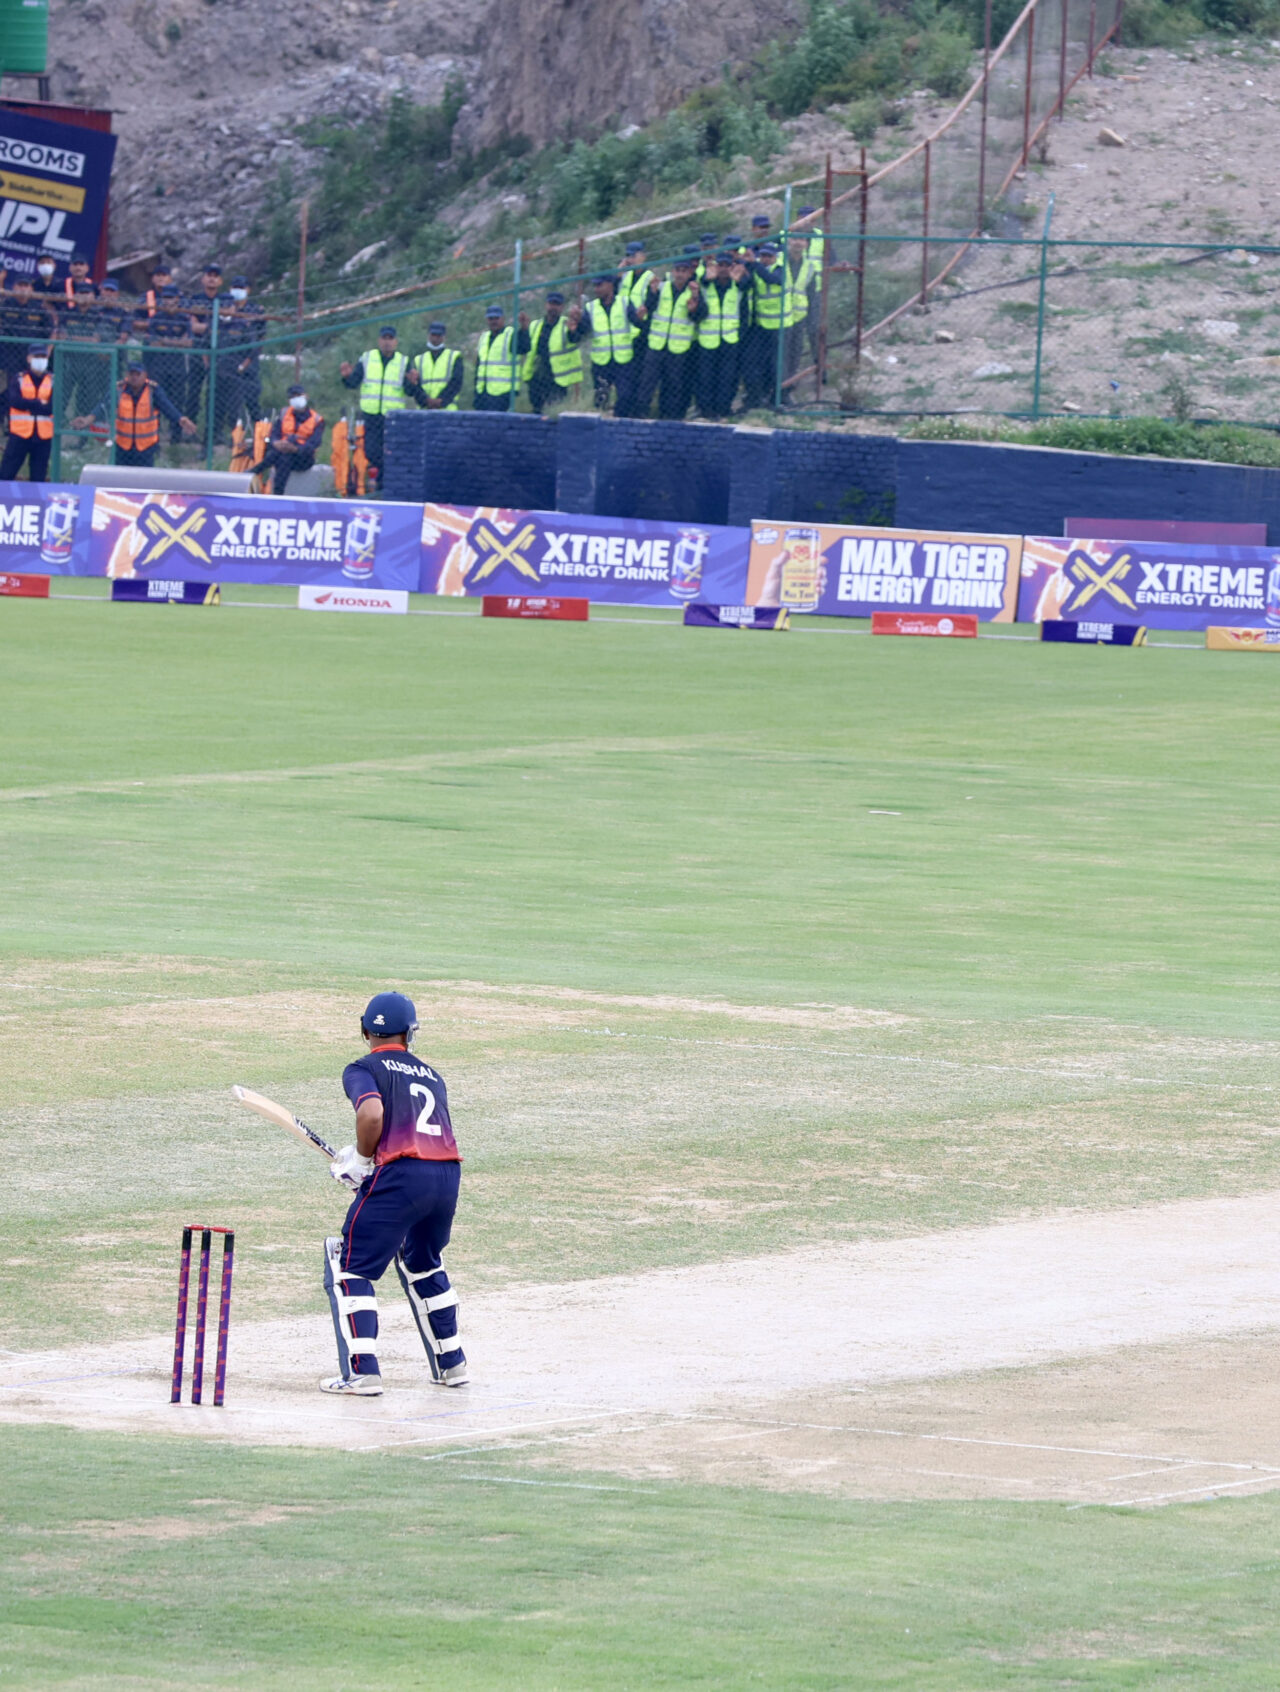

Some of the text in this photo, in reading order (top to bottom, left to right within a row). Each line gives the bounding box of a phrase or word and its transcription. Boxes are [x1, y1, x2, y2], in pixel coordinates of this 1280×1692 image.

[212, 514, 343, 549] XTREME
[210, 544, 343, 562] ENERGY DRINK
[541, 532, 671, 568] XTREME
[840, 538, 1007, 580] MAX TIGER
[539, 562, 670, 581] ENERGY DRINK
[1137, 561, 1265, 597] XTREME
[333, 597, 393, 608] HONDA
[837, 573, 1004, 608] ENERGY DRINK
[1135, 591, 1266, 609] ENERGY DRINK
[381, 1059, 438, 1082] KUSHAL
[409, 1082, 442, 1137] 2
